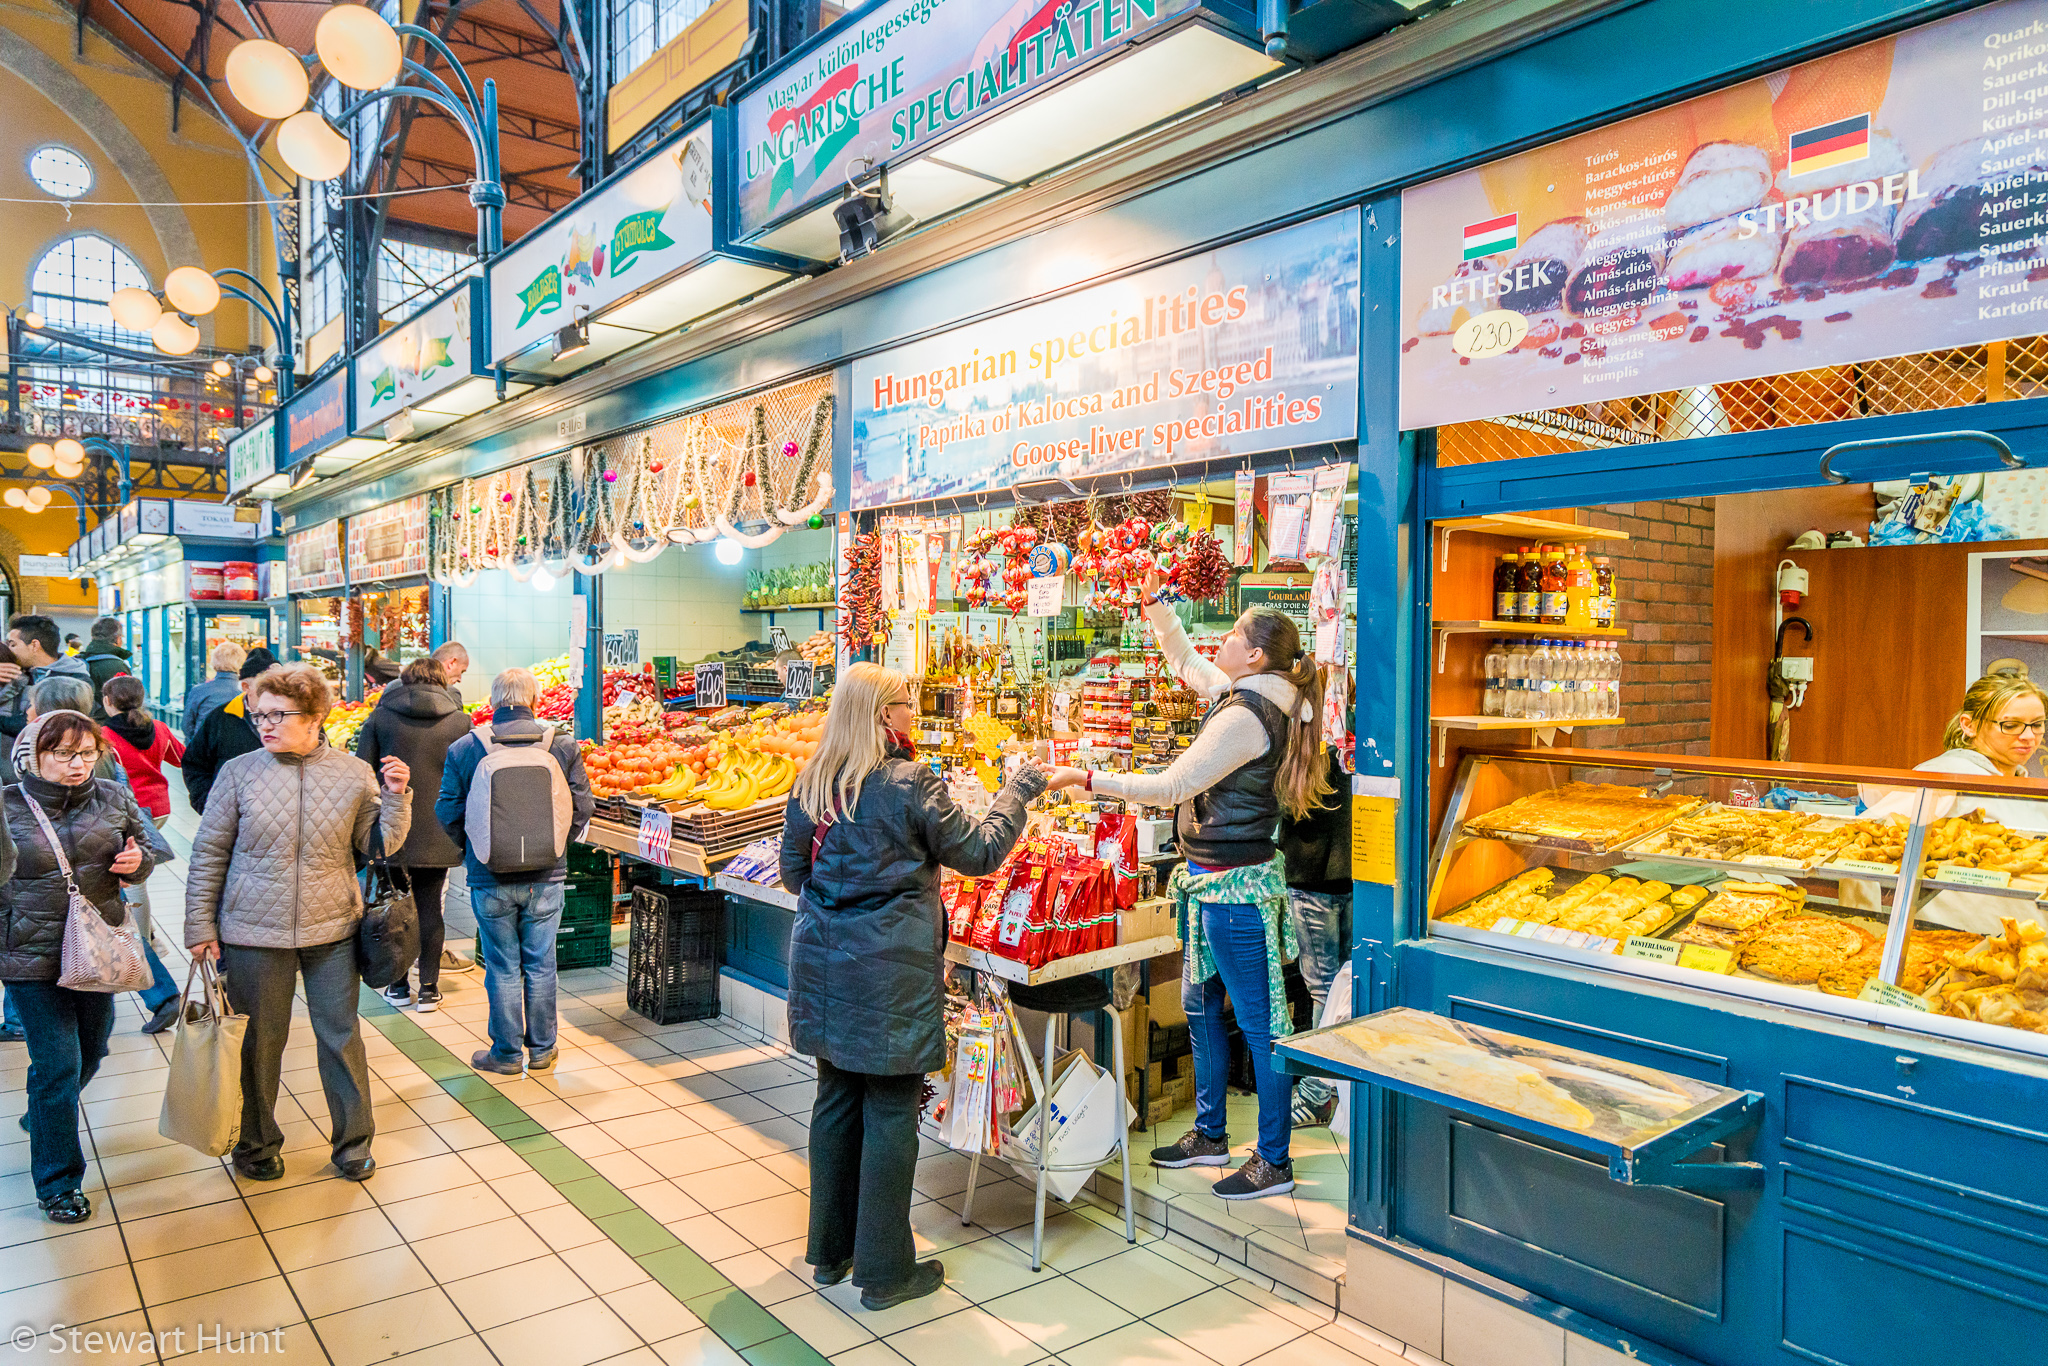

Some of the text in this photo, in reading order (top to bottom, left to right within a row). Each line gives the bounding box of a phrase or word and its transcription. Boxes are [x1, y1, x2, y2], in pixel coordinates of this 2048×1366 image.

[766, 0, 951, 117] Magyar különlegessége
[1983, 43, 2048, 71] Apriko
[891, 0, 1158, 152] SPECIALITÄTEN
[745, 55, 906, 182] UNGARISCHE
[1585, 149, 1619, 168] Túrós
[1585, 149, 1677, 184] Barackos-túrós
[1981, 147, 2048, 174] Sauerk
[1585, 168, 1676, 201] Meggyes-túrós
[1585, 188, 1664, 218] Kapros-túrós
[1737, 168, 1930, 241] STRUDEL
[1979, 192, 2048, 218] Apfel-z
[1585, 206, 1666, 235] Tökös-mákos
[1584, 223, 1667, 251] Almás-mákos
[1584, 237, 1683, 268] Meggyes-mákos
[1584, 261, 1652, 285] Almás-diós
[1979, 256, 2048, 278] Pflaum
[1431, 258, 1553, 311] RÉTESEK
[1584, 275, 1670, 301] Almás-fahéjas
[1979, 279, 2030, 299] Kraut
[1584, 289, 1679, 318] Meggyes-almás
[1028, 283, 1249, 381] specialities
[1583, 316, 1636, 335] Meggyes
[1583, 324, 1684, 352] Szilvás-meggyes
[1583, 349, 1644, 368] Káposztás
[873, 347, 1017, 412] Hungarian
[1583, 366, 1639, 384] Krumplis
[919, 345, 1274, 455] Paprika of Kalocsa and Szeged
[1012, 393, 1323, 469] Goose-liver specialities
[1264, 601, 1282, 609] GRAS
[1698, 948, 1716, 956] PIZZA
